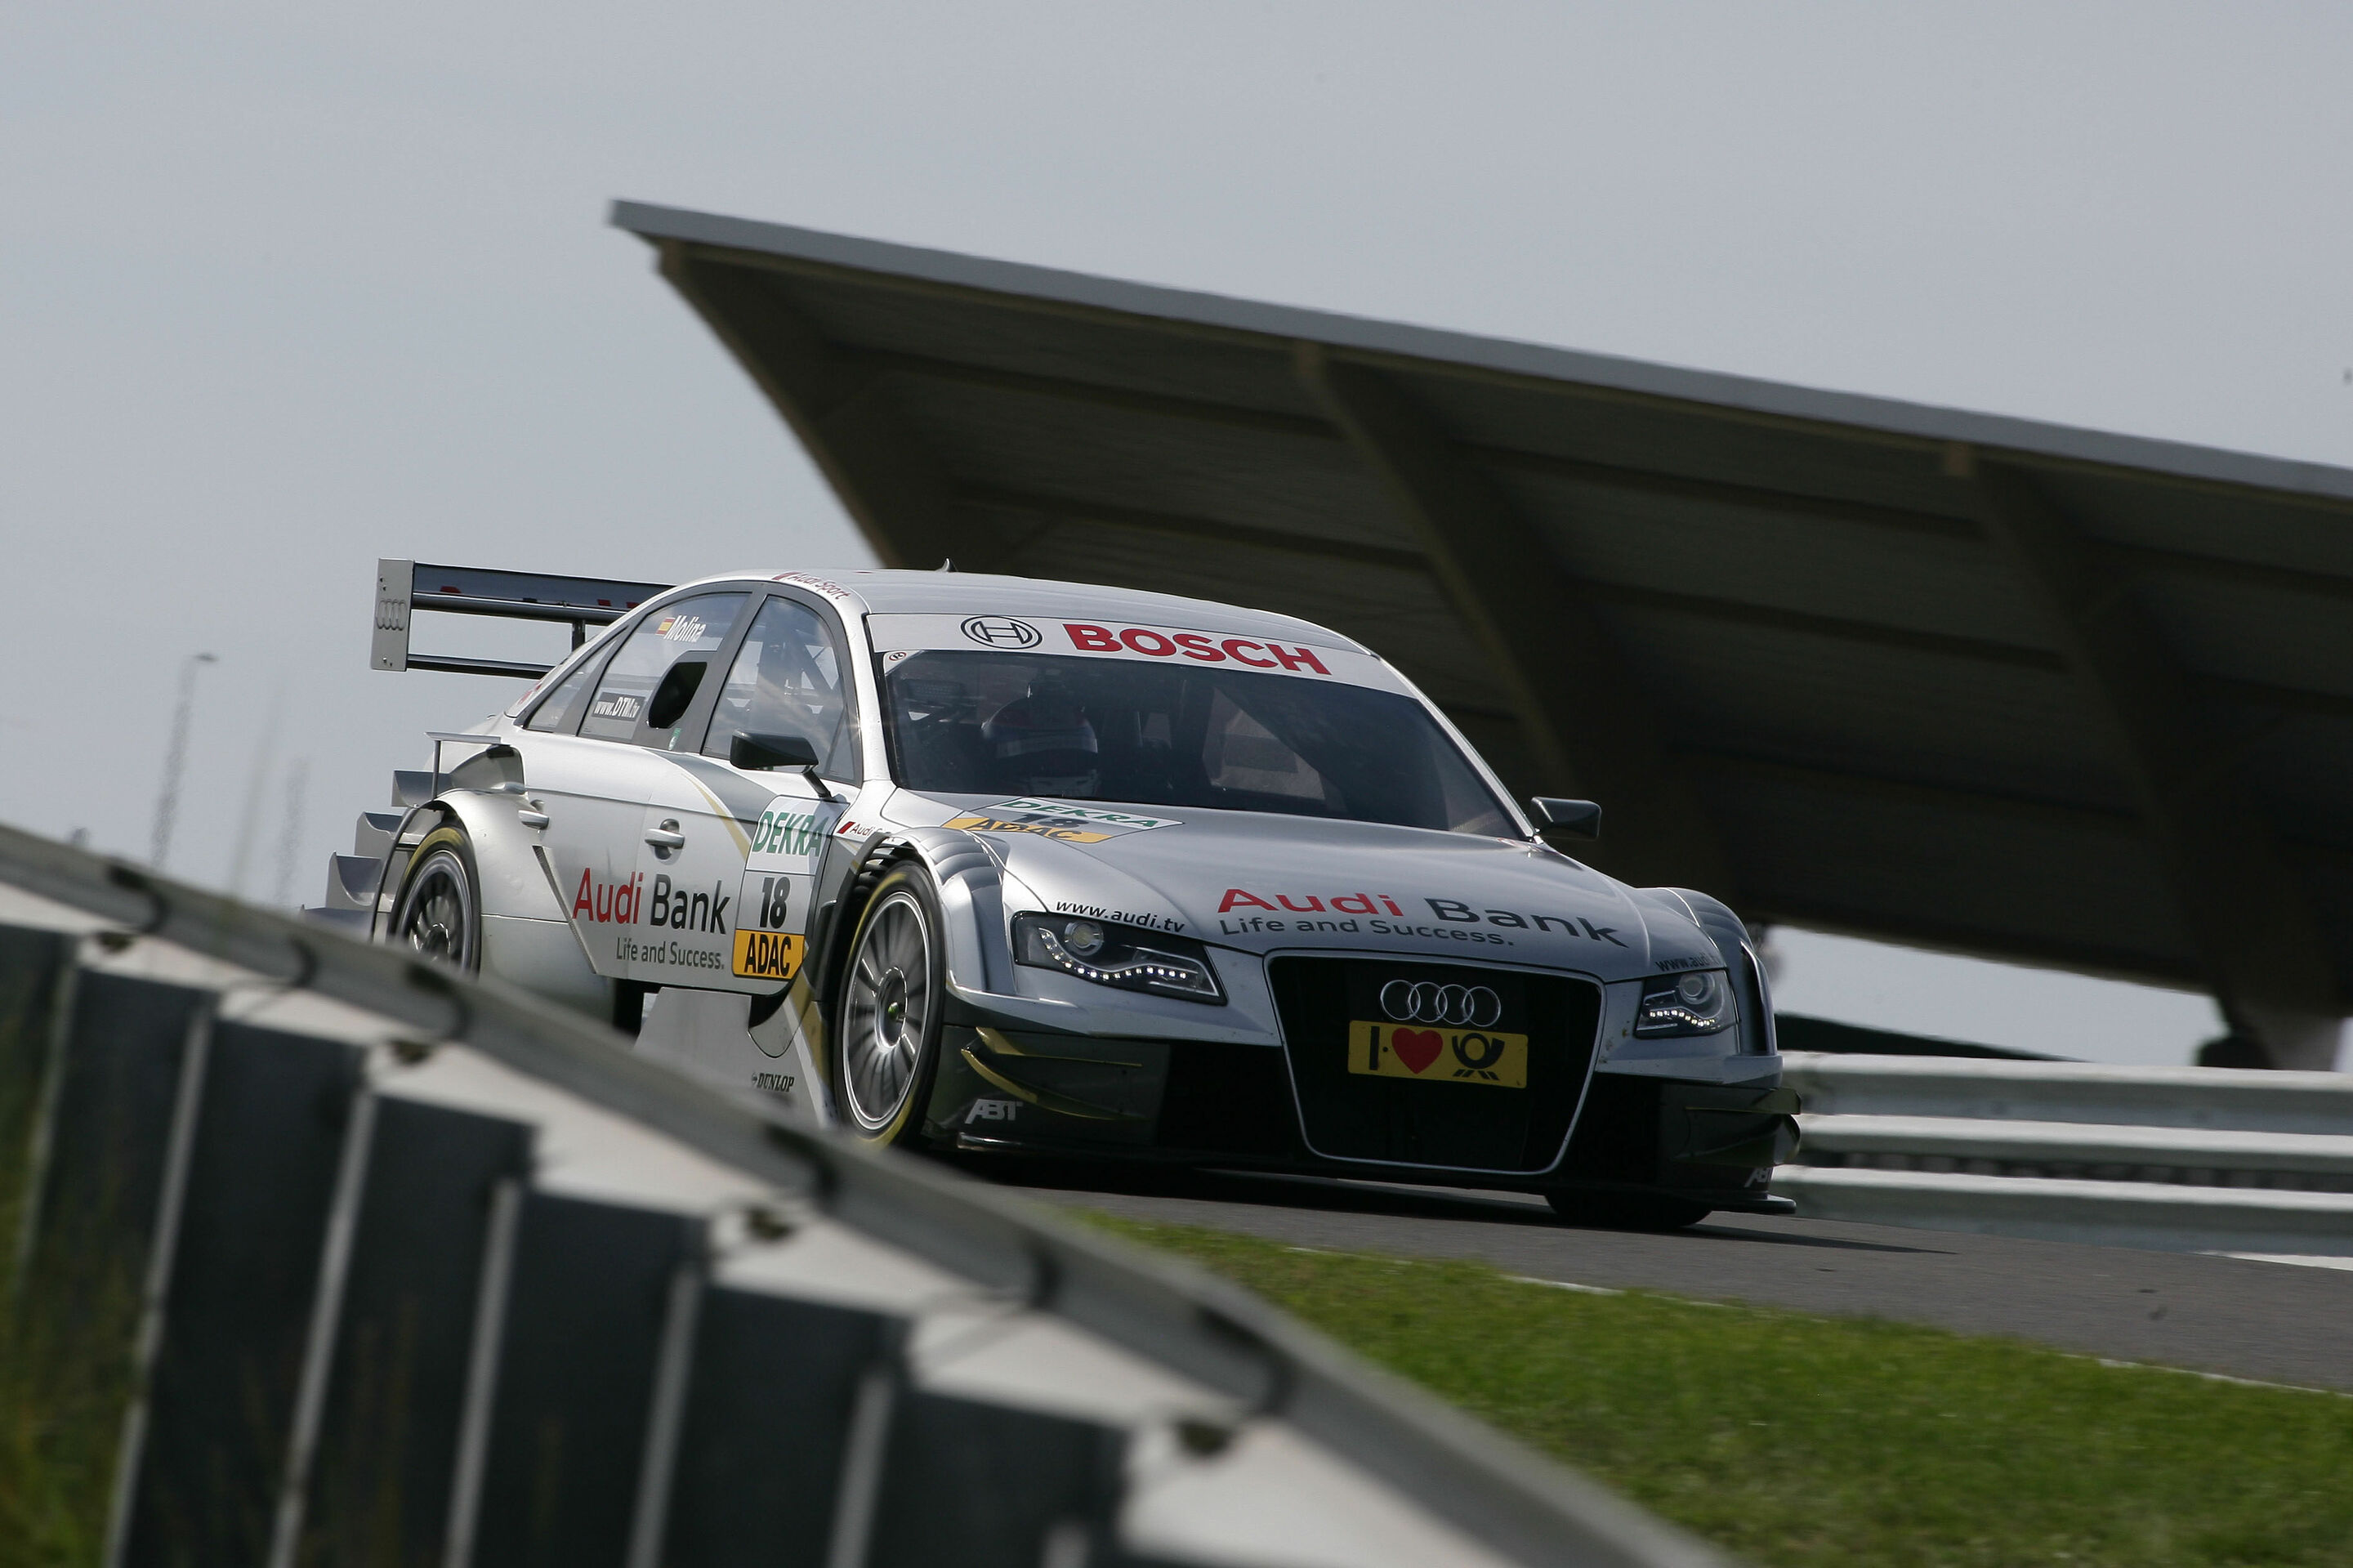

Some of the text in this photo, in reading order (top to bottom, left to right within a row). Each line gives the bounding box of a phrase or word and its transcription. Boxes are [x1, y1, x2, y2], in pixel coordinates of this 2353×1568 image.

[815, 581, 851, 600] Sport
[663, 615, 706, 642] Molina
[1062, 623, 1333, 676] BOSCH
[594, 697, 641, 718] www.DTM.tv
[1000, 801, 1159, 828] DEKRA
[1012, 813, 1089, 829] 18
[752, 811, 828, 857] DEKRA
[850, 823, 876, 837] Audi
[962, 818, 1083, 839] ADAC
[573, 868, 730, 935] Audi Bank
[759, 876, 791, 929] 18
[1056, 901, 1185, 931] www.audi.tv
[1217, 888, 1629, 948] Audi Bank
[1219, 918, 1514, 946] Life and Success.
[616, 937, 725, 970] Life and Success.
[744, 933, 791, 976] ADAC
[757, 1073, 794, 1092] DUNLOP
[965, 1098, 1024, 1124] ABT
